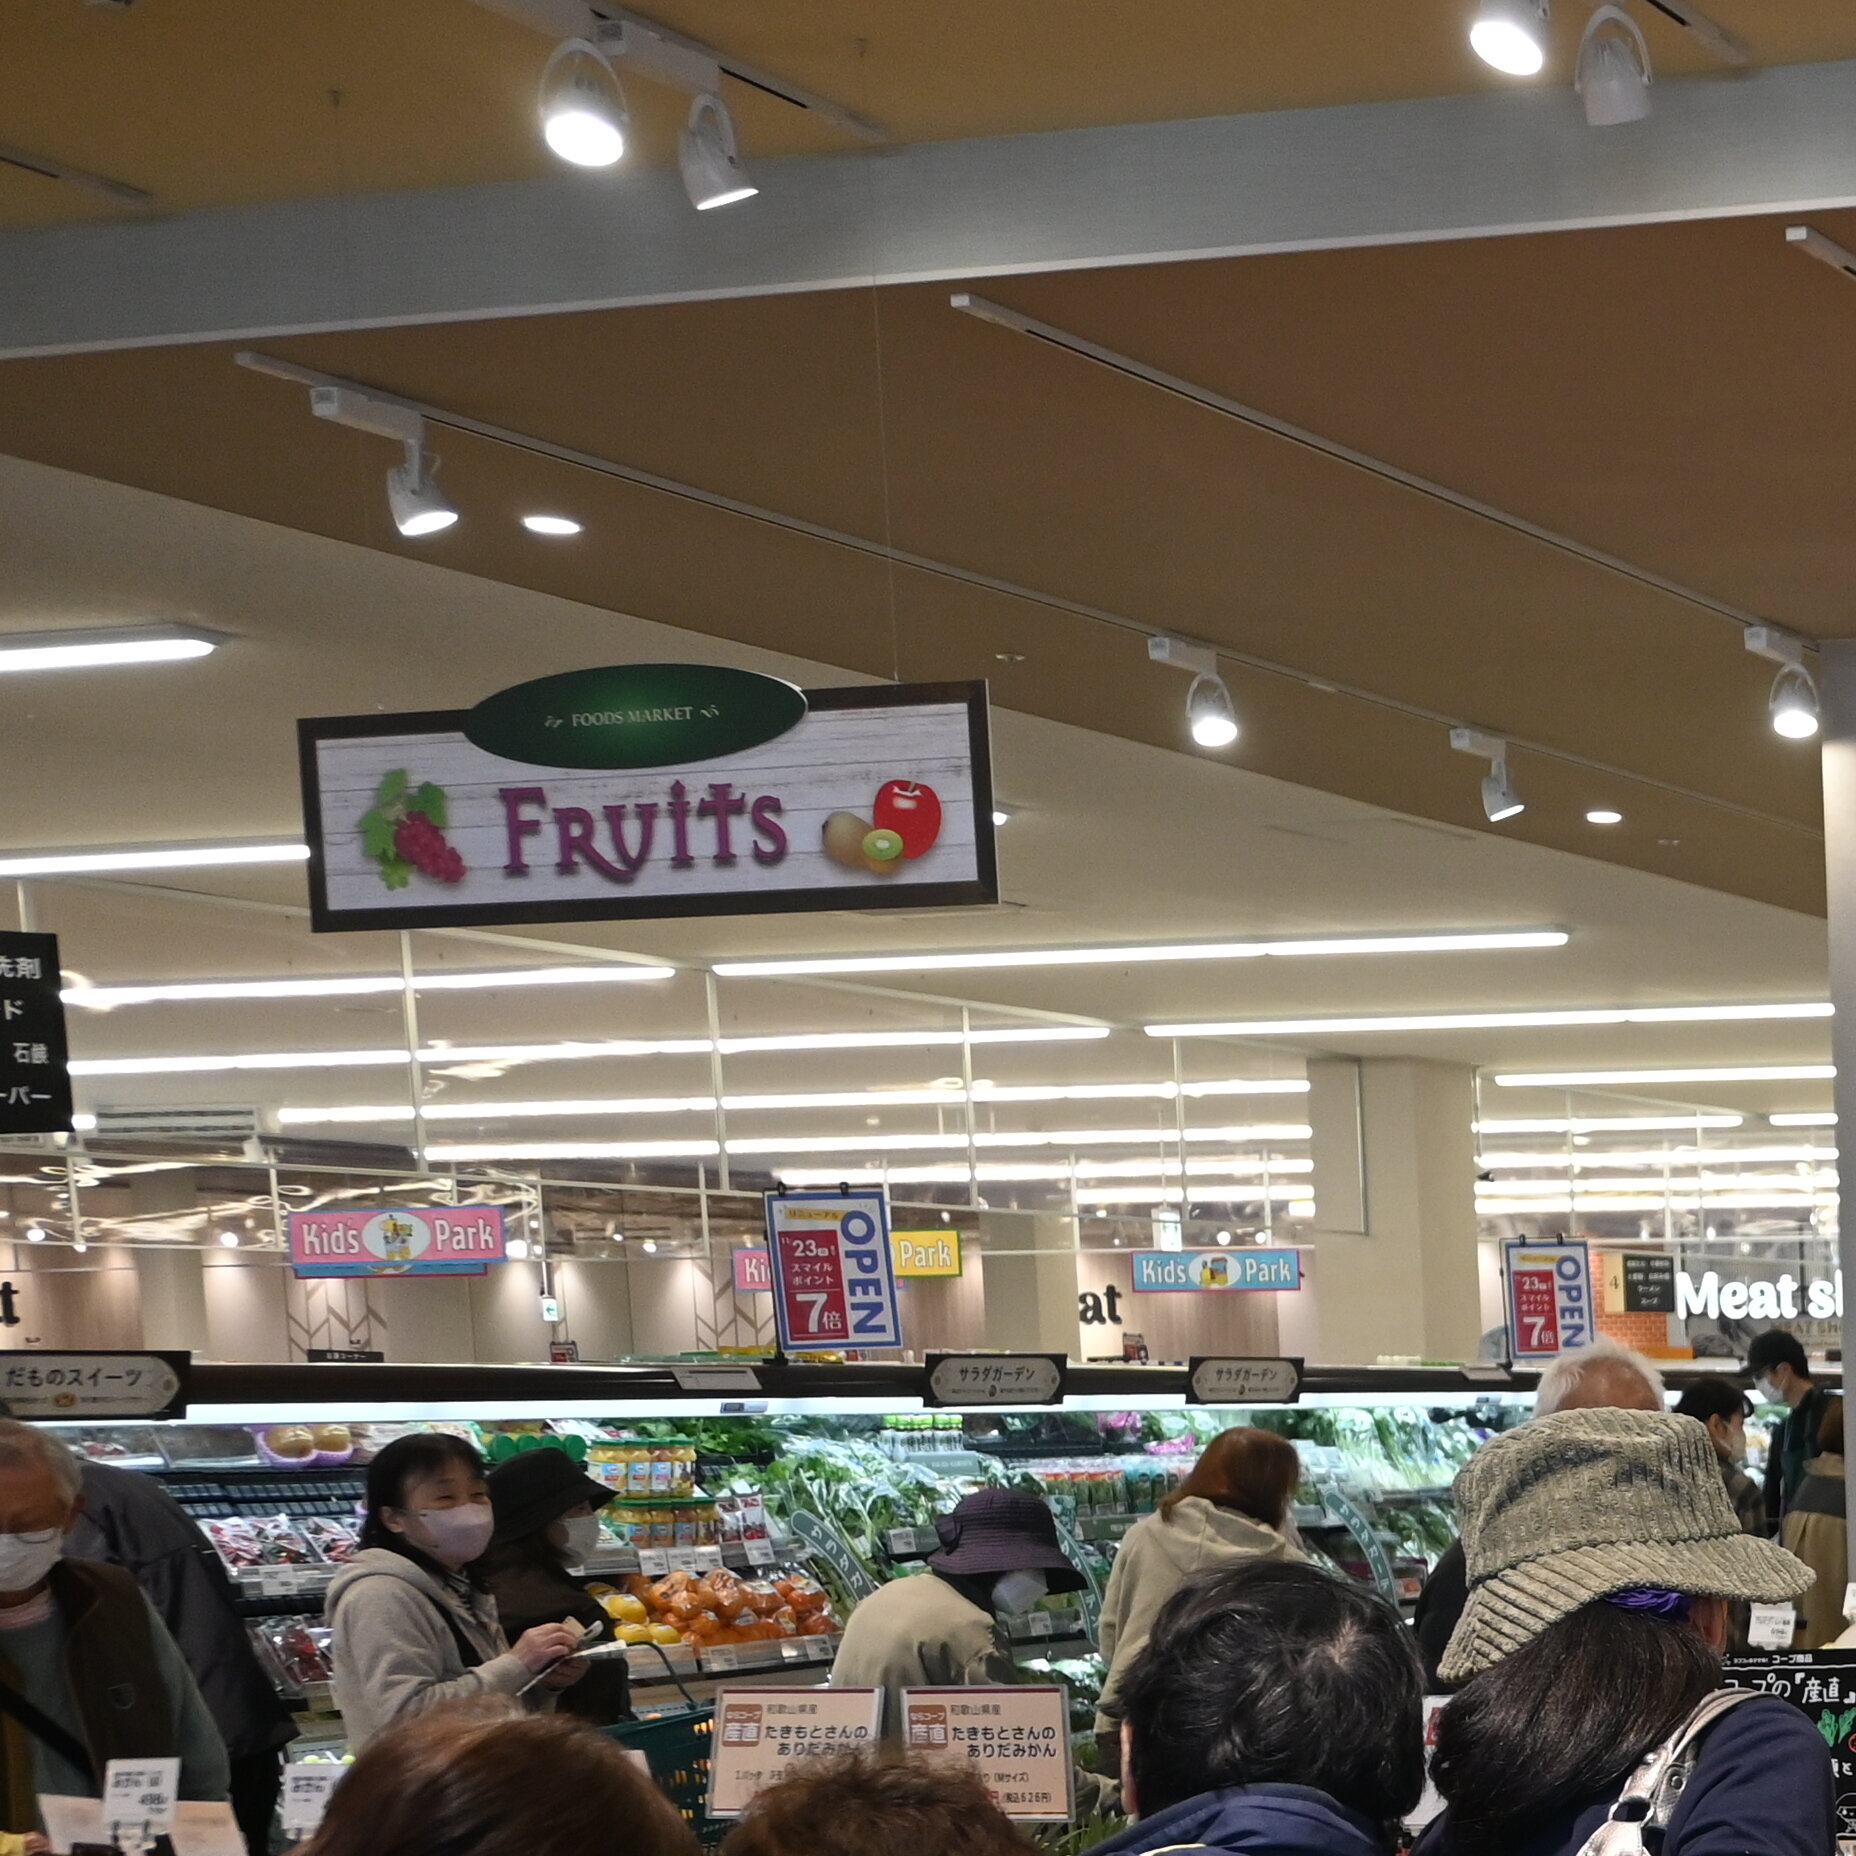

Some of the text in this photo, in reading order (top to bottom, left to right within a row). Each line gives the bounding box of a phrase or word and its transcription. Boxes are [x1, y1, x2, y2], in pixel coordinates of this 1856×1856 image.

[572, 706, 692, 727] FOODS MARKET
[435, 1218, 494, 1250] Park
[900, 1239, 951, 1268] Park
[745, 1258, 770, 1283] Ki
[792, 1263, 833, 1273] スマイル
[841, 1210, 887, 1334] OPEN
[1245, 1258, 1291, 1282] Park
[792, 1275, 834, 1286] ポイント
[1556, 1255, 1585, 1347] OPEN
[1675, 1271, 1798, 1320] Meat
[796, 1293, 841, 1333] 7倍
[959, 1366, 1035, 1380] サラダガーデン
[765, 1725, 868, 1739] たきもとさんの
[952, 1726, 1056, 1740] たきもとさんの
[968, 1743, 1056, 1757] ありだみかん
